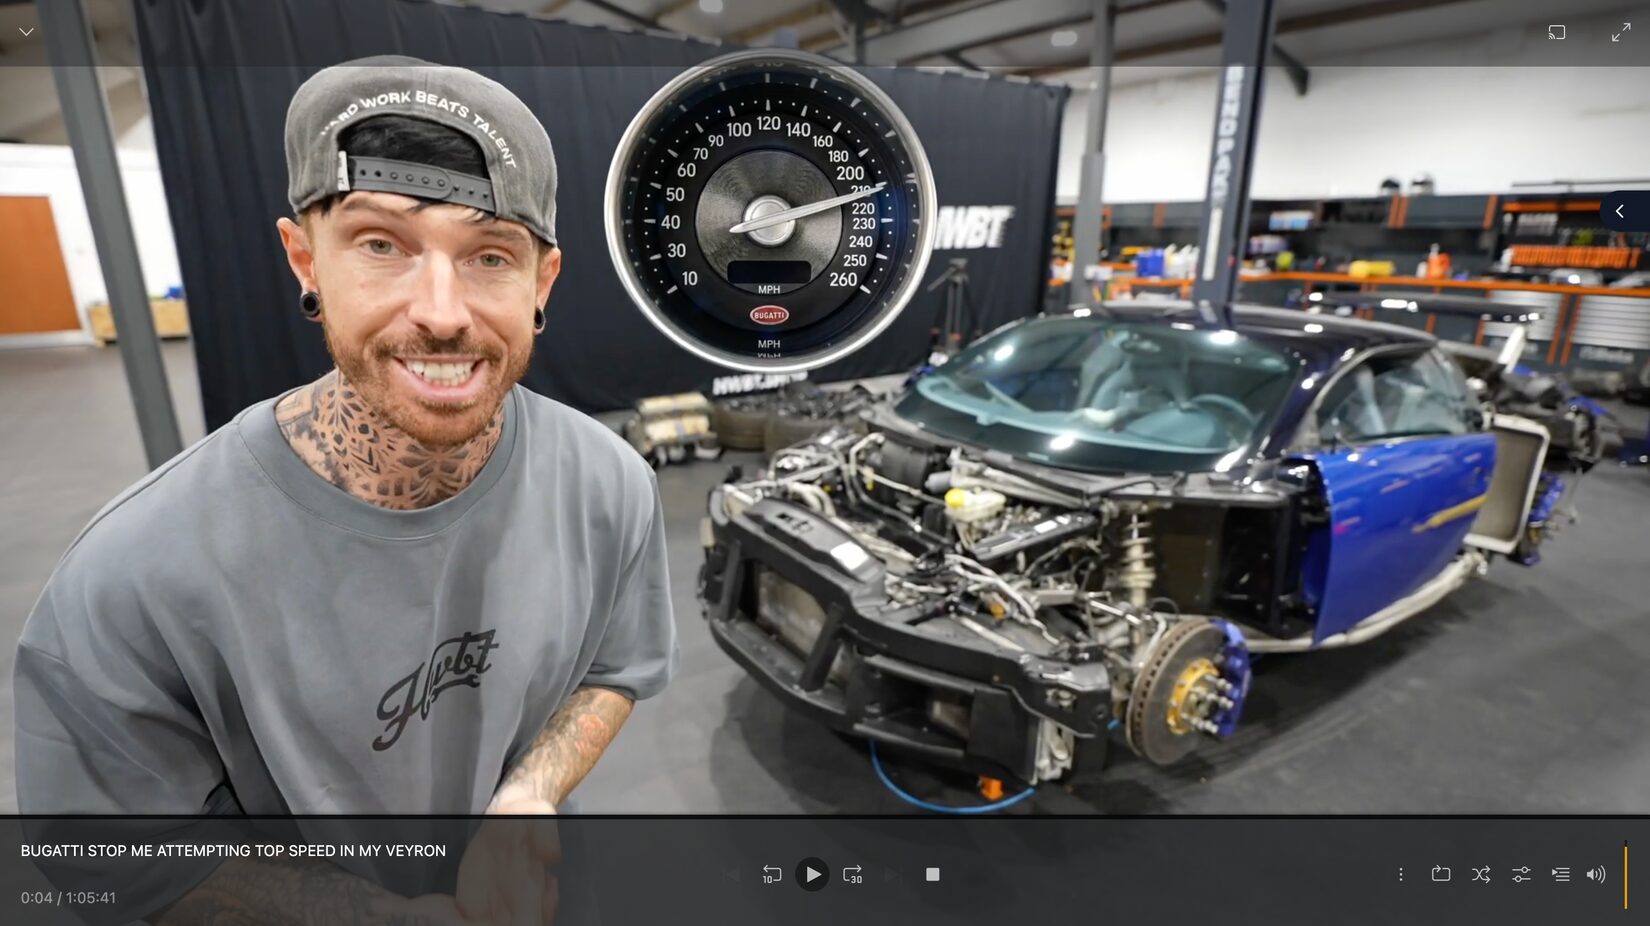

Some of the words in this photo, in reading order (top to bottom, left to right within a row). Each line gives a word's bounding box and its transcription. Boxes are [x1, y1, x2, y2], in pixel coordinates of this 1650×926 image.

[360, 90, 411, 108] WORK
[415, 90, 470, 118] BEATS
[473, 113, 517, 168] TALENT
